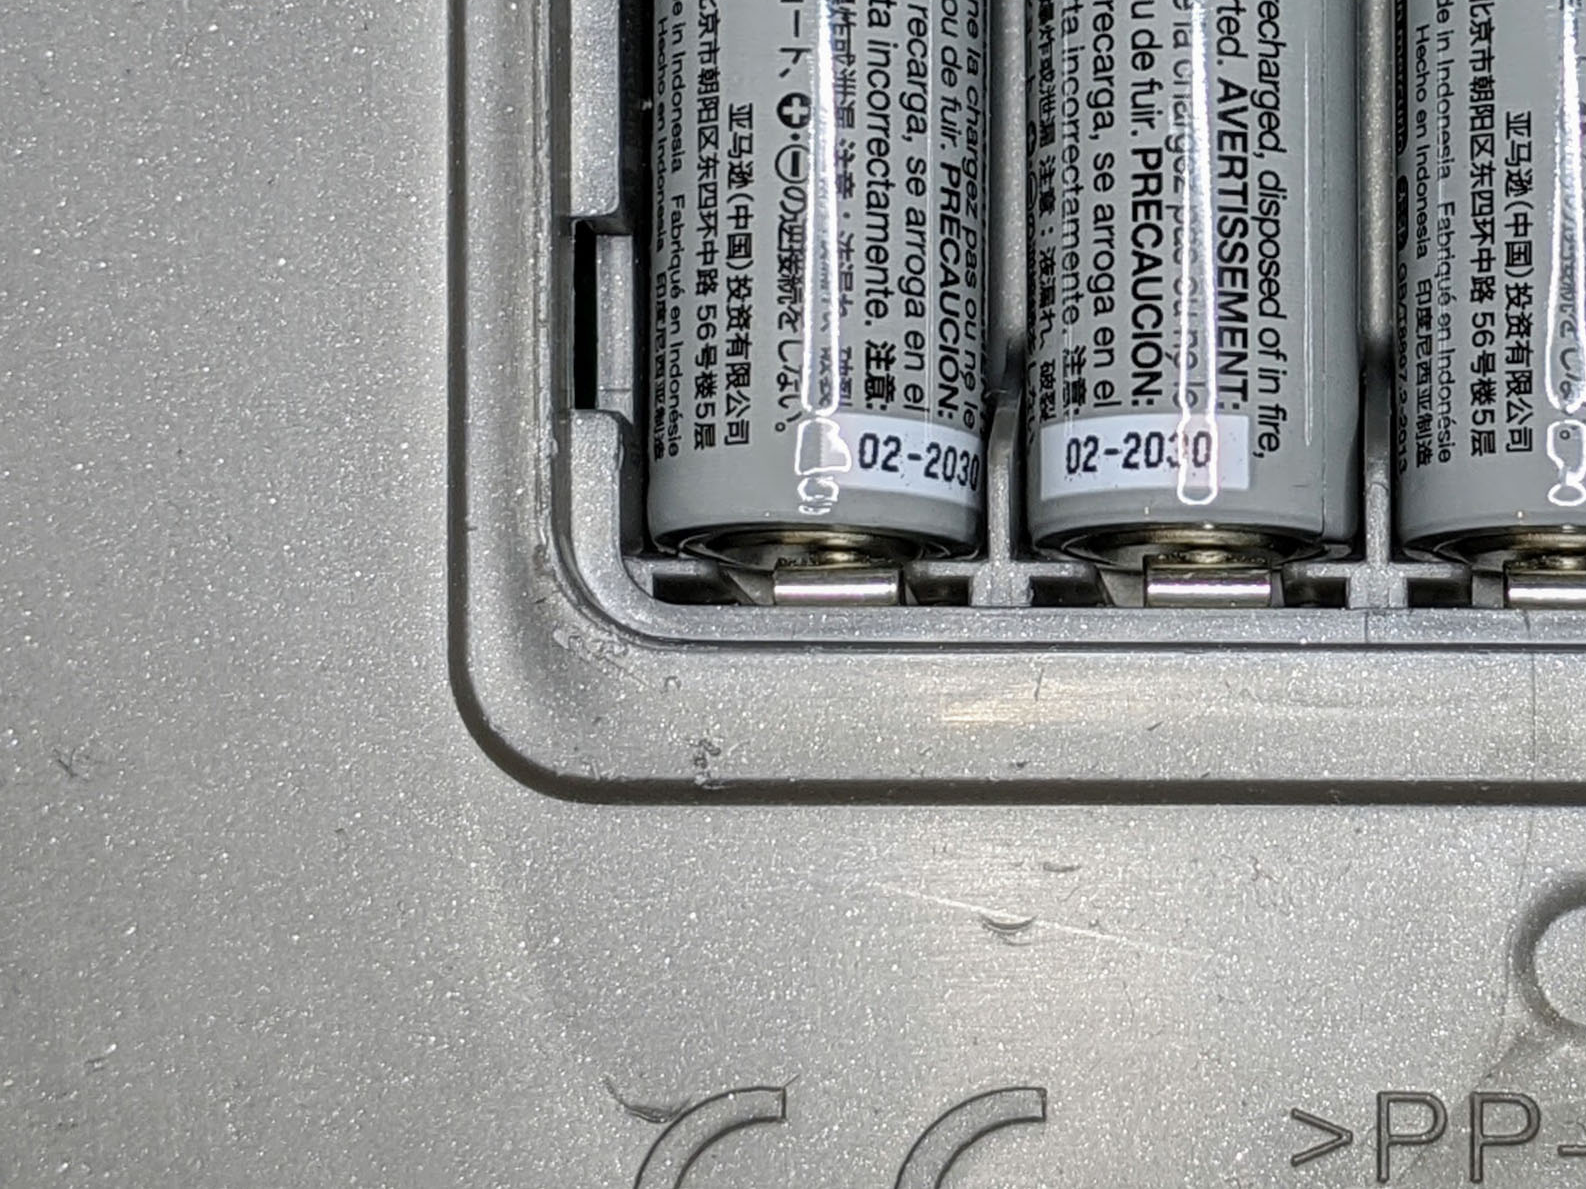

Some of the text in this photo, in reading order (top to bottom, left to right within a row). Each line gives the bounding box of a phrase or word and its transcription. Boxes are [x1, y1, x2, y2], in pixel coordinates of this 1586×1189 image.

[671, 21, 687, 47] in
[1130, 28, 1164, 72] de
[1415, 23, 1432, 104] Hecho
[1435, 20, 1455, 54] in
[898, 3, 929, 143] recarga,
[940, 44, 964, 89] de
[670, 50, 687, 175] Indonesia
[939, 95, 963, 151] fuir.
[1130, 77, 1164, 137] fuir.
[1415, 108, 1428, 140] en
[1433, 58, 1456, 185] Indonesia
[864, 39, 899, 327] incorrectamente.
[904, 155, 928, 198] se
[1057, 39, 1086, 336] incorrectamente.
[1092, 151, 1116, 193] se
[1415, 143, 1432, 261] Indonesia
[666, 193, 686, 300] Fabriqué
[896, 206, 927, 319] arroga
[1085, 203, 1116, 318] arroga
[1216, 76, 1250, 411] AVERTISSEMENT:
[1249, 169, 1288, 321] disposed
[1433, 189, 1458, 307] Fabriqué
[936, 161, 967, 421] PRECAUCIÓN:
[1130, 146, 1164, 407] PRECAUCIÓN:
[669, 304, 681, 336] en
[1092, 326, 1116, 369] en
[1257, 326, 1288, 363] of
[1436, 312, 1452, 343] en
[903, 329, 926, 372] en
[1257, 366, 1288, 395] in
[667, 340, 685, 458] Indonésie
[902, 382, 931, 414] el
[1092, 379, 1123, 409] el
[1436, 347, 1458, 464] Indonésie
[1251, 402, 1288, 459] fire,
[857, 431, 981, 492] 02-2030
